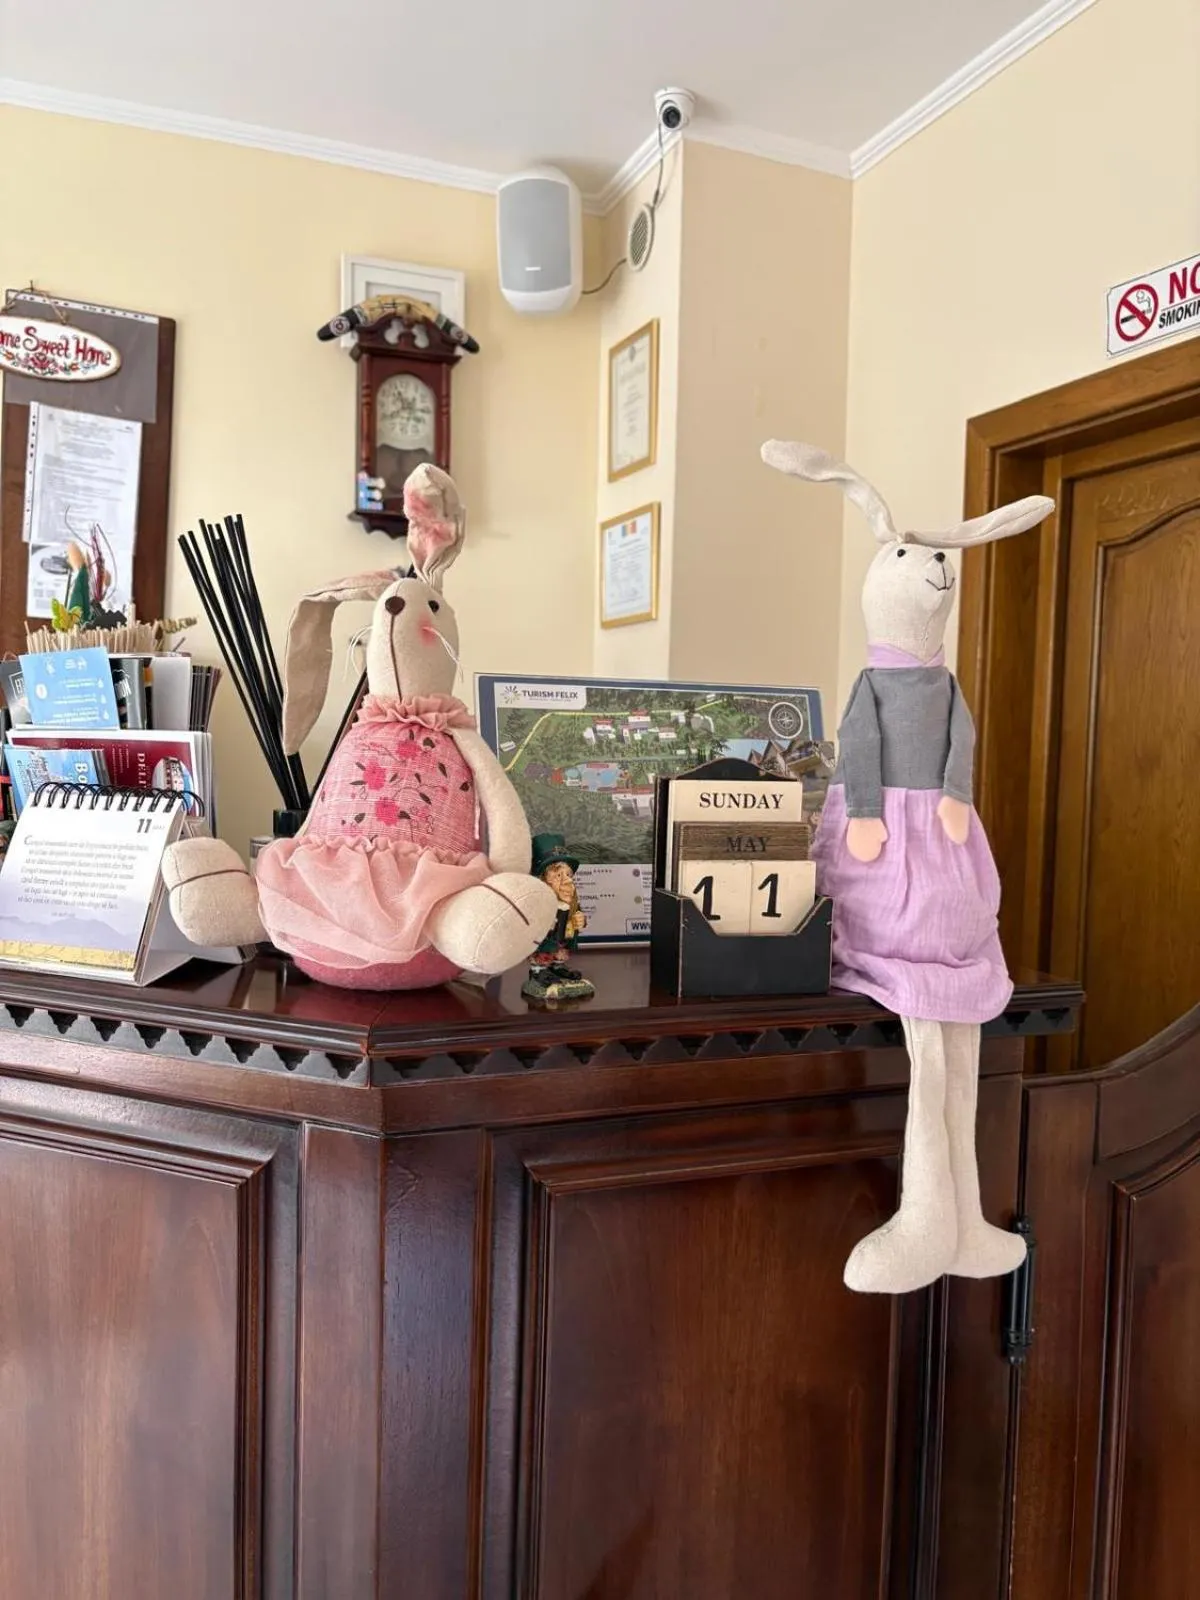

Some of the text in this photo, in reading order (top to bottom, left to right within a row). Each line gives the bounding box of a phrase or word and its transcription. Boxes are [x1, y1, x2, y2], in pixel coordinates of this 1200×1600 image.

[22, 326, 71, 359] Sweet
[73, 335, 111, 366] Home
[521, 690, 578, 699] TURISM FELIX
[699, 792, 784, 810] SUNDAY
[726, 836, 771, 853] MAY
